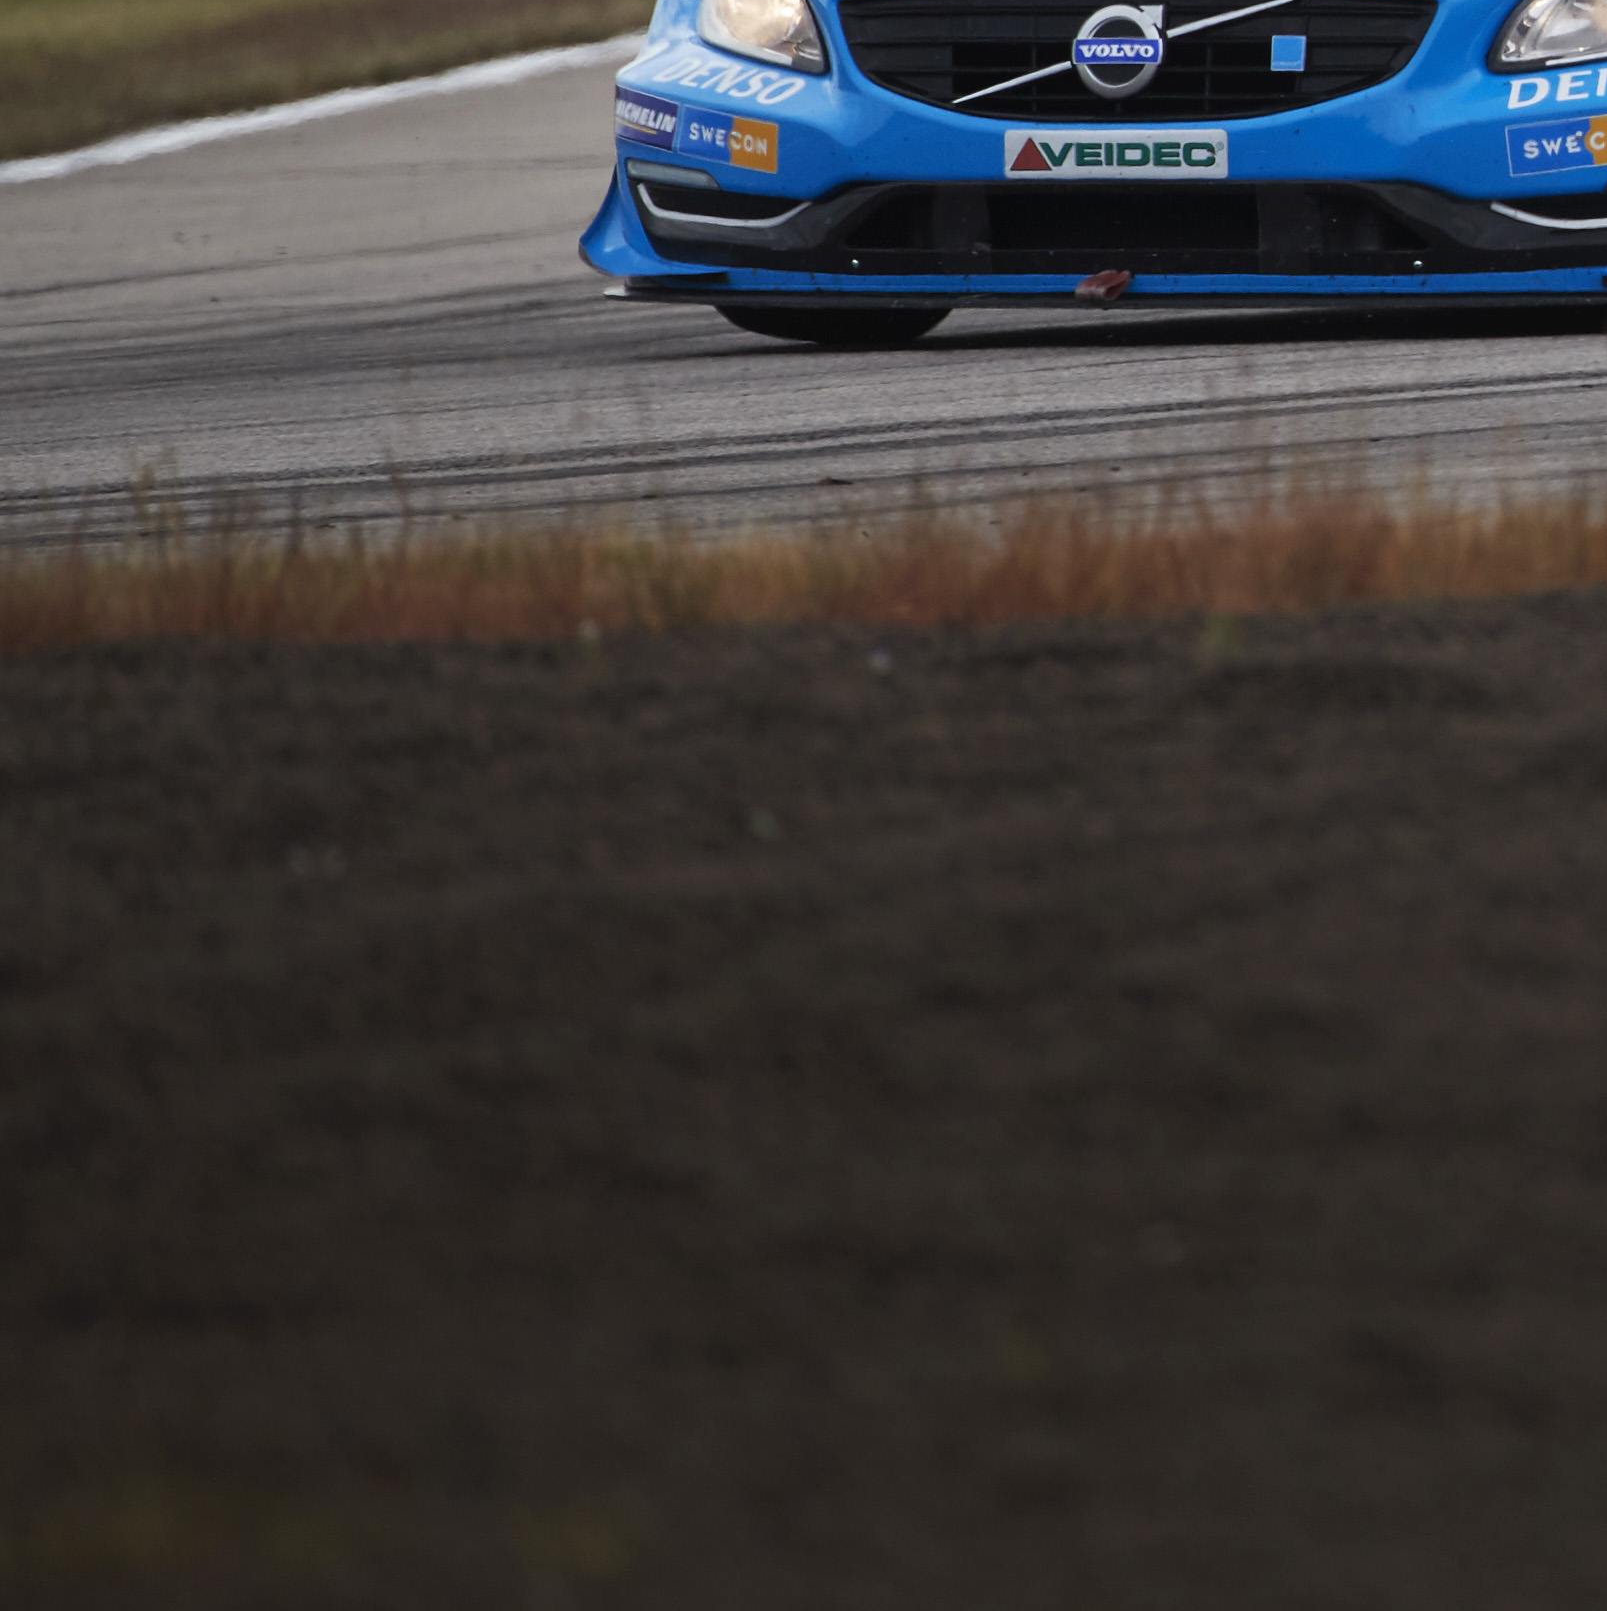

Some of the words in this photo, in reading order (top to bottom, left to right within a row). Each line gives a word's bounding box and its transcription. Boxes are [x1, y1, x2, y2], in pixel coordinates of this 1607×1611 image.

[1079, 44, 1154, 58] VOLVO
[653, 57, 806, 105] DENSO
[1039, 142, 1216, 167] VEIDEC
